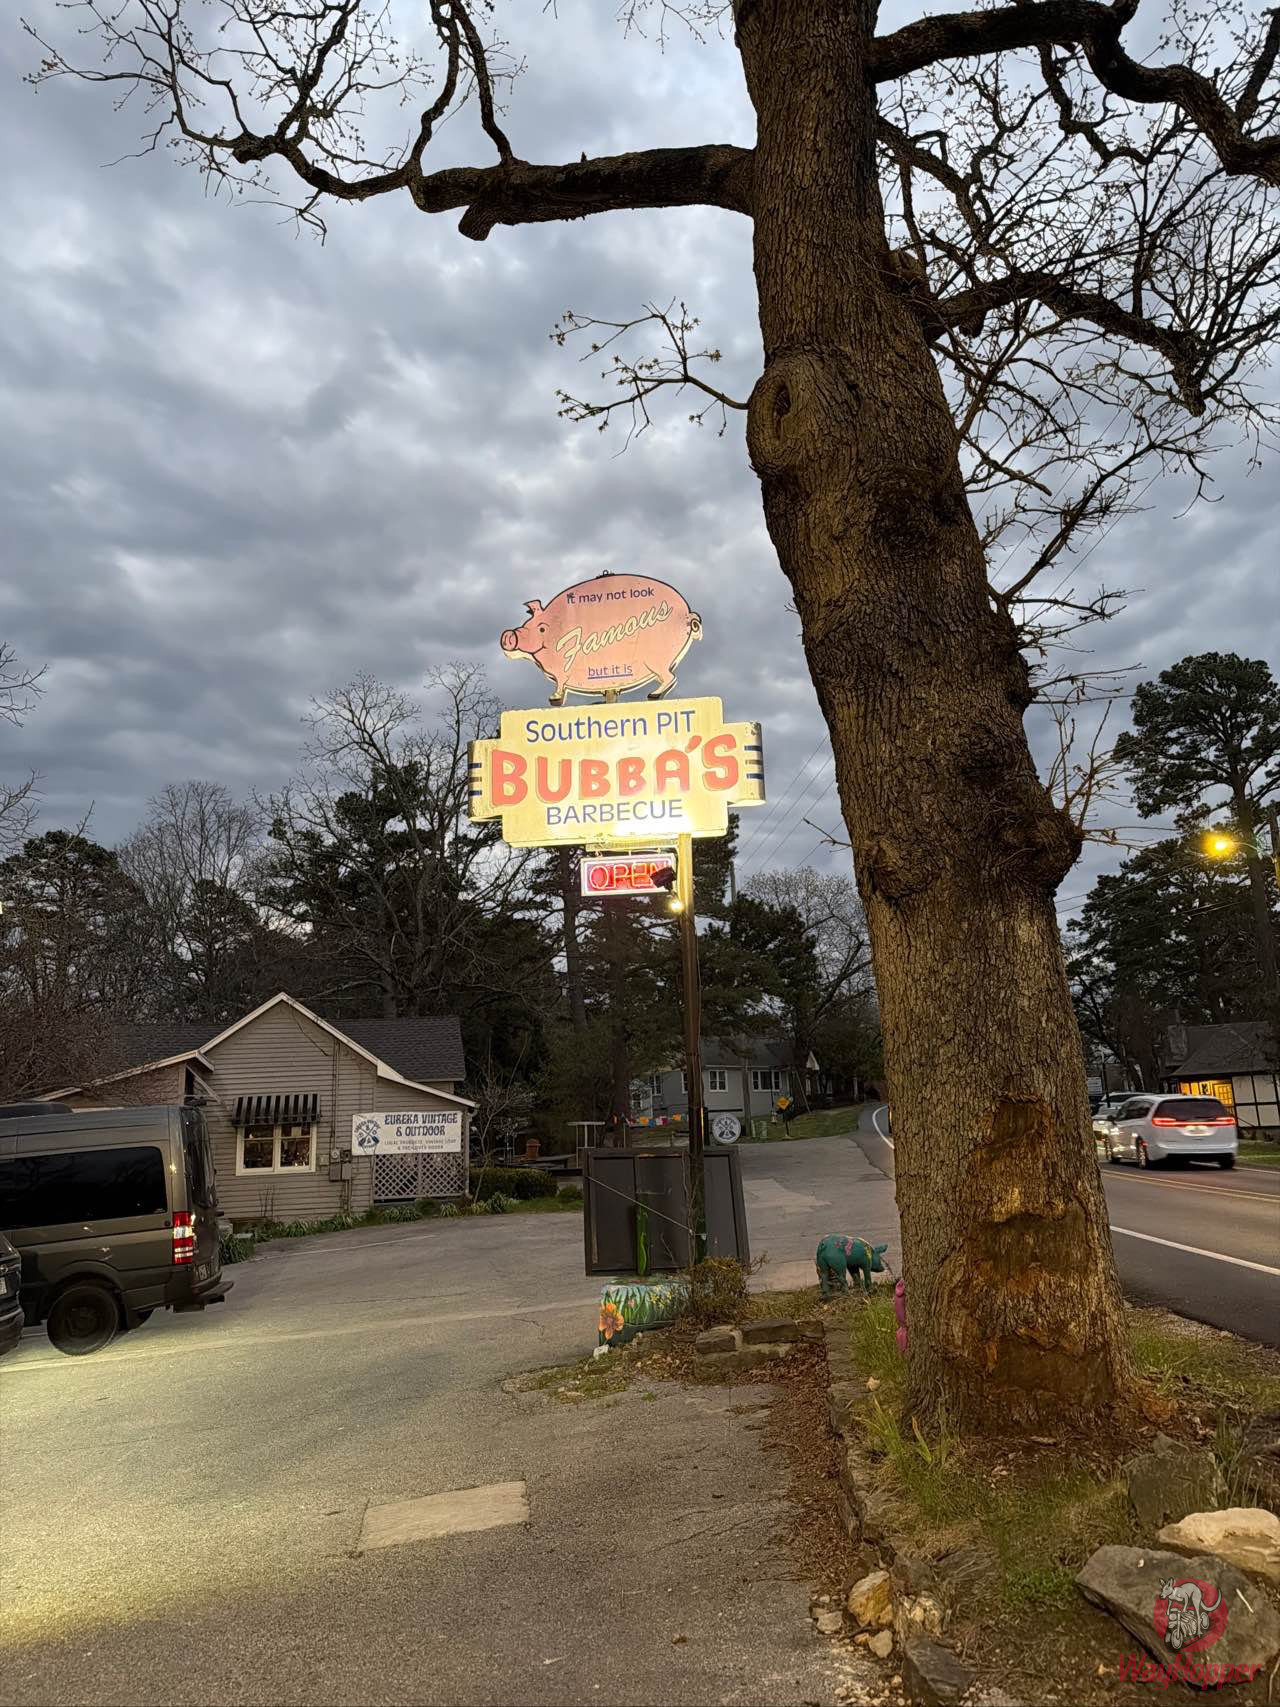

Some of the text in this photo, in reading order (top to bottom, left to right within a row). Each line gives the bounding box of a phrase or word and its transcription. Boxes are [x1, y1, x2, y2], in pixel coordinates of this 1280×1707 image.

[578, 592, 603, 604] may
[606, 589, 626, 601] not
[629, 586, 655, 599] look
[556, 600, 673, 673] Famous
[588, 663, 633, 677] but it is
[526, 710, 696, 743] Southern PIT
[491, 733, 740, 808] BUBBA'S
[545, 799, 683, 826] BARBECUE
[384, 1112, 458, 1126] EUREKA VINTAGE
[395, 1125, 446, 1137] & OUTDOOR
